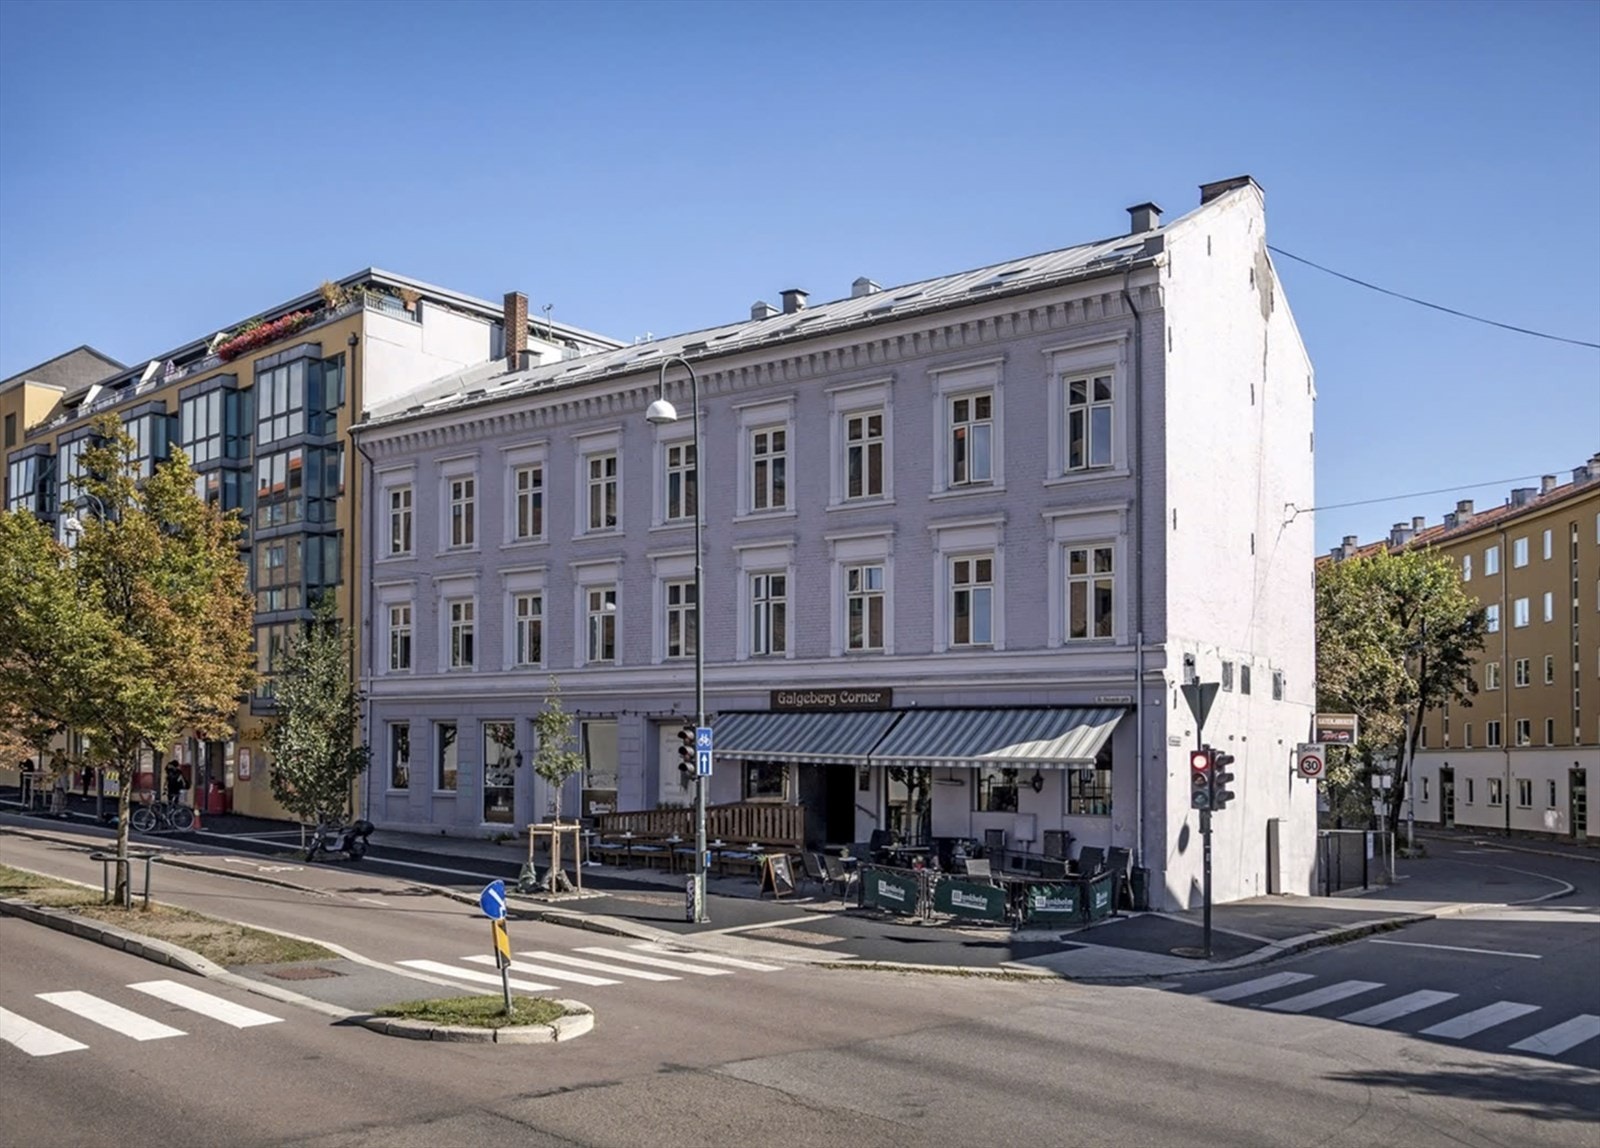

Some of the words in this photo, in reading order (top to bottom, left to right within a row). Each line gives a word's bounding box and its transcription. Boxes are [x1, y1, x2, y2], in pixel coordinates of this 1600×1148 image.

[778, 692, 836, 707] Galgeberg
[839, 690, 881, 704] Corner
[1302, 745, 1321, 753] Sone
[1305, 760, 1318, 771] 30
